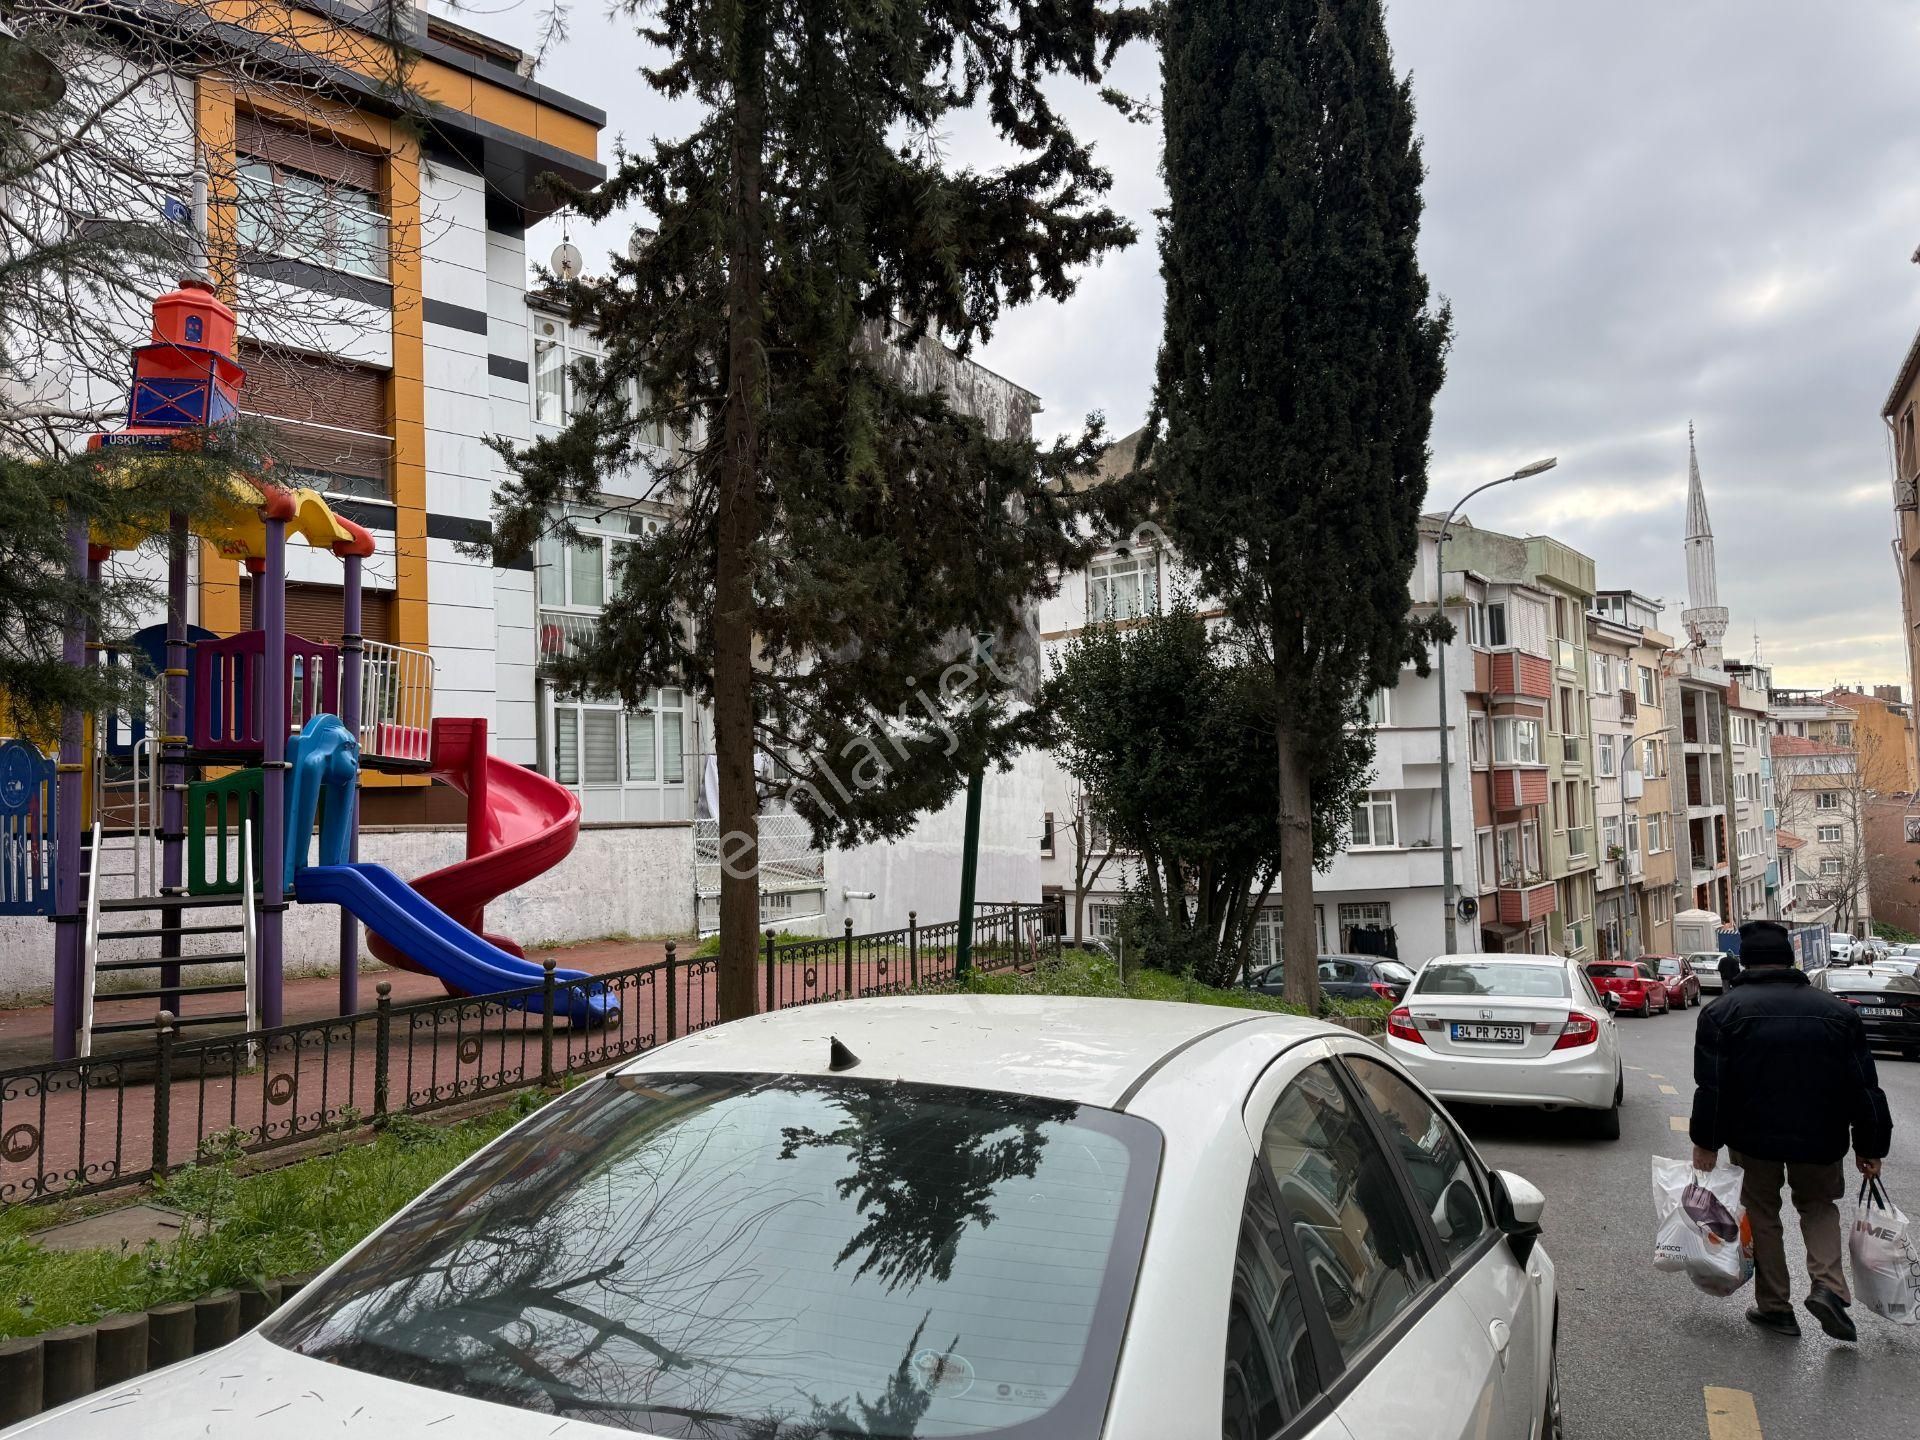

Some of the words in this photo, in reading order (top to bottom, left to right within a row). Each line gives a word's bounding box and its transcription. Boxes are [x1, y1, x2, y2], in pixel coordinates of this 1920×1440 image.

[1458, 1026, 1471, 1037] 34
[1476, 1026, 1489, 1038] PR
[1494, 1027, 1520, 1039] 7533
